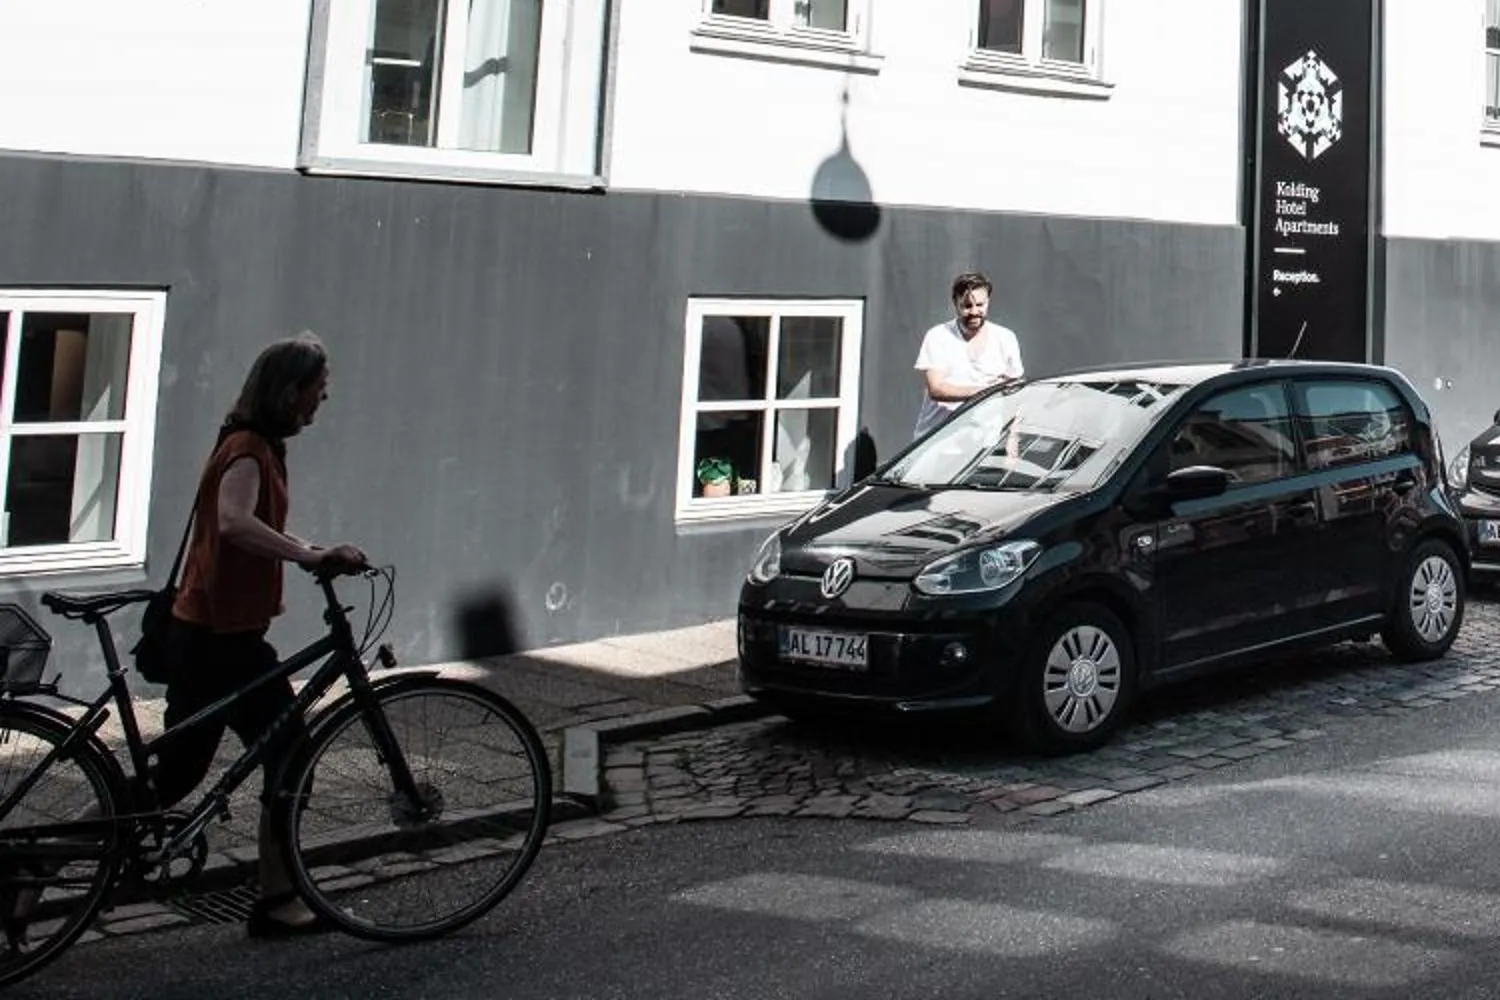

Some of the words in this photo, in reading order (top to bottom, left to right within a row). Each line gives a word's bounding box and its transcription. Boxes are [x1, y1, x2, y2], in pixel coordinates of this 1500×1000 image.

[1276, 181, 1320, 203] Kolding
[1276, 199, 1307, 215] Hotel
[1275, 217, 1339, 236] Apartments
[792, 633, 811, 656] AL
[815, 635, 833, 657] 17
[835, 637, 866, 660] 744
